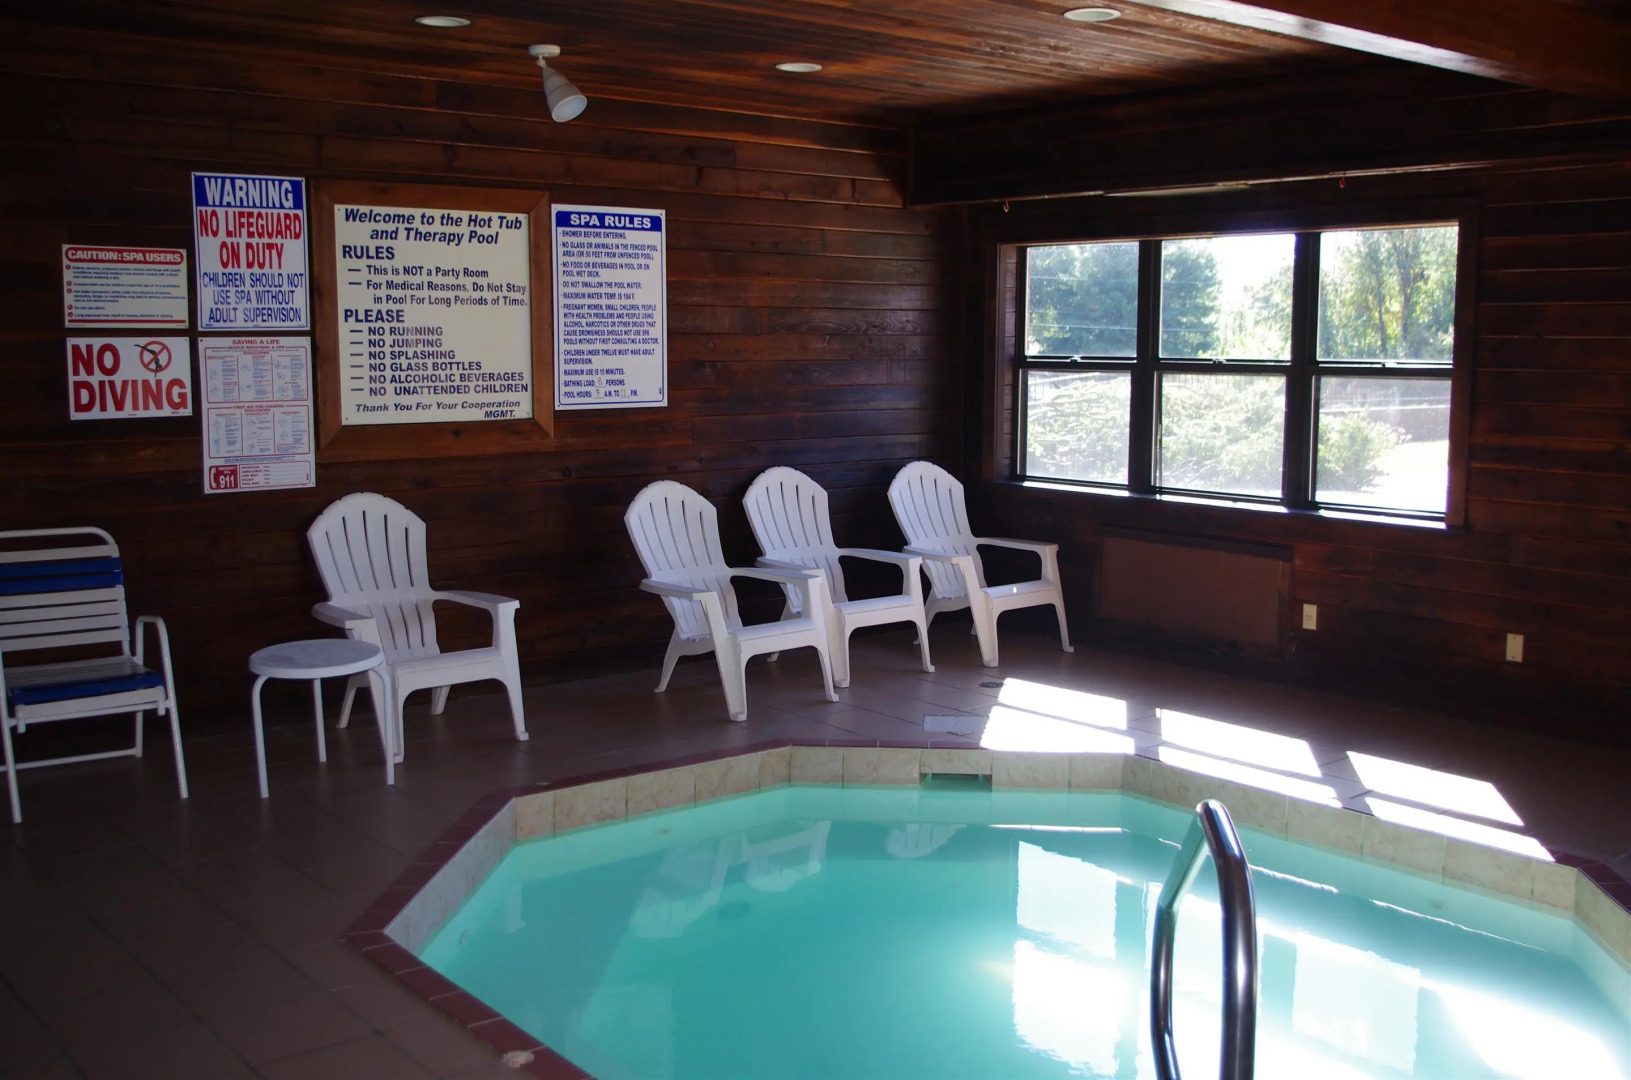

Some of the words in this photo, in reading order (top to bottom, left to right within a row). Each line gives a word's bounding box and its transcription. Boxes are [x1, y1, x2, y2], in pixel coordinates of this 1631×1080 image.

[204, 177, 294, 209] WARNING
[199, 209, 220, 238] NO
[225, 210, 302, 240] LIFEGUARD
[345, 208, 415, 225] Welcome
[420, 212, 435, 226] to
[440, 213, 463, 227] the
[467, 214, 493, 228] Hot
[498, 215, 522, 230] Tub
[570, 214, 600, 226] SPA
[605, 215, 651, 229] RULES
[370, 226, 399, 240] and
[404, 227, 464, 246] Therapy
[468, 230, 499, 244] Pool
[562, 229, 582, 238] SHOWER
[583, 231, 602, 239] BEFORE
[342, 245, 395, 260] RULES
[562, 241, 569, 249] NO
[570, 241, 585, 249] GLASS
[594, 242, 614, 250] ANIMALS
[620, 243, 629, 251] THE
[647, 244, 658, 252] POOL
[68, 250, 121, 260] CAUTION:
[122, 252, 144, 261] SPA
[145, 253, 181, 263] USERS
[219, 240, 241, 269] ON
[245, 242, 284, 270] DUTY
[576, 250, 584, 258] (OR
[585, 250, 591, 258] 50
[604, 251, 617, 259] FROM
[366, 264, 388, 276] This
[391, 265, 400, 276] is
[403, 265, 424, 276] NOT
[435, 266, 460, 279] Party
[463, 267, 489, 278] Room
[570, 261, 583, 269] FOOD
[584, 261, 591, 269] OR
[562, 269, 575, 277] POOL
[202, 272, 246, 288] CHILDREN
[249, 272, 284, 288] SHOULD
[287, 273, 304, 288] NOT
[563, 280, 570, 288] DO
[581, 281, 603, 289] SWALLOW
[604, 281, 613, 289] THE
[366, 279, 383, 290] For
[386, 280, 424, 291] Medical
[427, 281, 468, 292] Reasons,
[472, 282, 484, 292] Do
[487, 282, 503, 293] Not
[506, 282, 526, 295] Stay
[213, 289, 231, 305] USE
[234, 289, 252, 305] SPA
[254, 289, 295, 305] WITHOUT
[373, 294, 383, 304] in
[386, 294, 407, 305] Pool
[410, 294, 425, 305] For
[428, 295, 451, 307] Long
[454, 295, 488, 306] Periods
[491, 296, 500, 306] of
[502, 296, 528, 306] Time.
[563, 303, 586, 311] PREGNANT
[208, 307, 238, 323] ADULT
[243, 307, 301, 323] SUPERVISION
[344, 309, 405, 323] PLEASE
[368, 326, 385, 336] NO
[389, 326, 443, 336] RUNNING
[563, 329, 578, 337] CAUSE
[578, 329, 606, 337] DROWSINESS
[368, 338, 386, 348] NO
[389, 338, 442, 348] JUMPING
[368, 350, 386, 360] NO
[390, 350, 455, 360] SPLASHING
[564, 349, 585, 357] CHILDREN
[71, 343, 121, 377] NO
[369, 362, 386, 372] NO
[390, 362, 428, 372] GLASS
[432, 361, 482, 371] BOTTLES
[369, 374, 386, 384] NO
[390, 373, 456, 384] ALCOHOLIC
[459, 372, 524, 383] BEVERAGES
[594, 368, 599, 376] IS
[73, 378, 188, 413] DIVING
[369, 386, 387, 397] NO
[394, 385, 470, 396] UNATTENDED
[474, 383, 528, 394] CHILDREN
[355, 403, 389, 412] Thank
[394, 403, 413, 411] You
[415, 402, 432, 410] For
[436, 402, 458, 410] Your
[461, 399, 520, 410] Cooperation
[484, 410, 515, 418] MGMT.
[219, 475, 234, 488] 911
